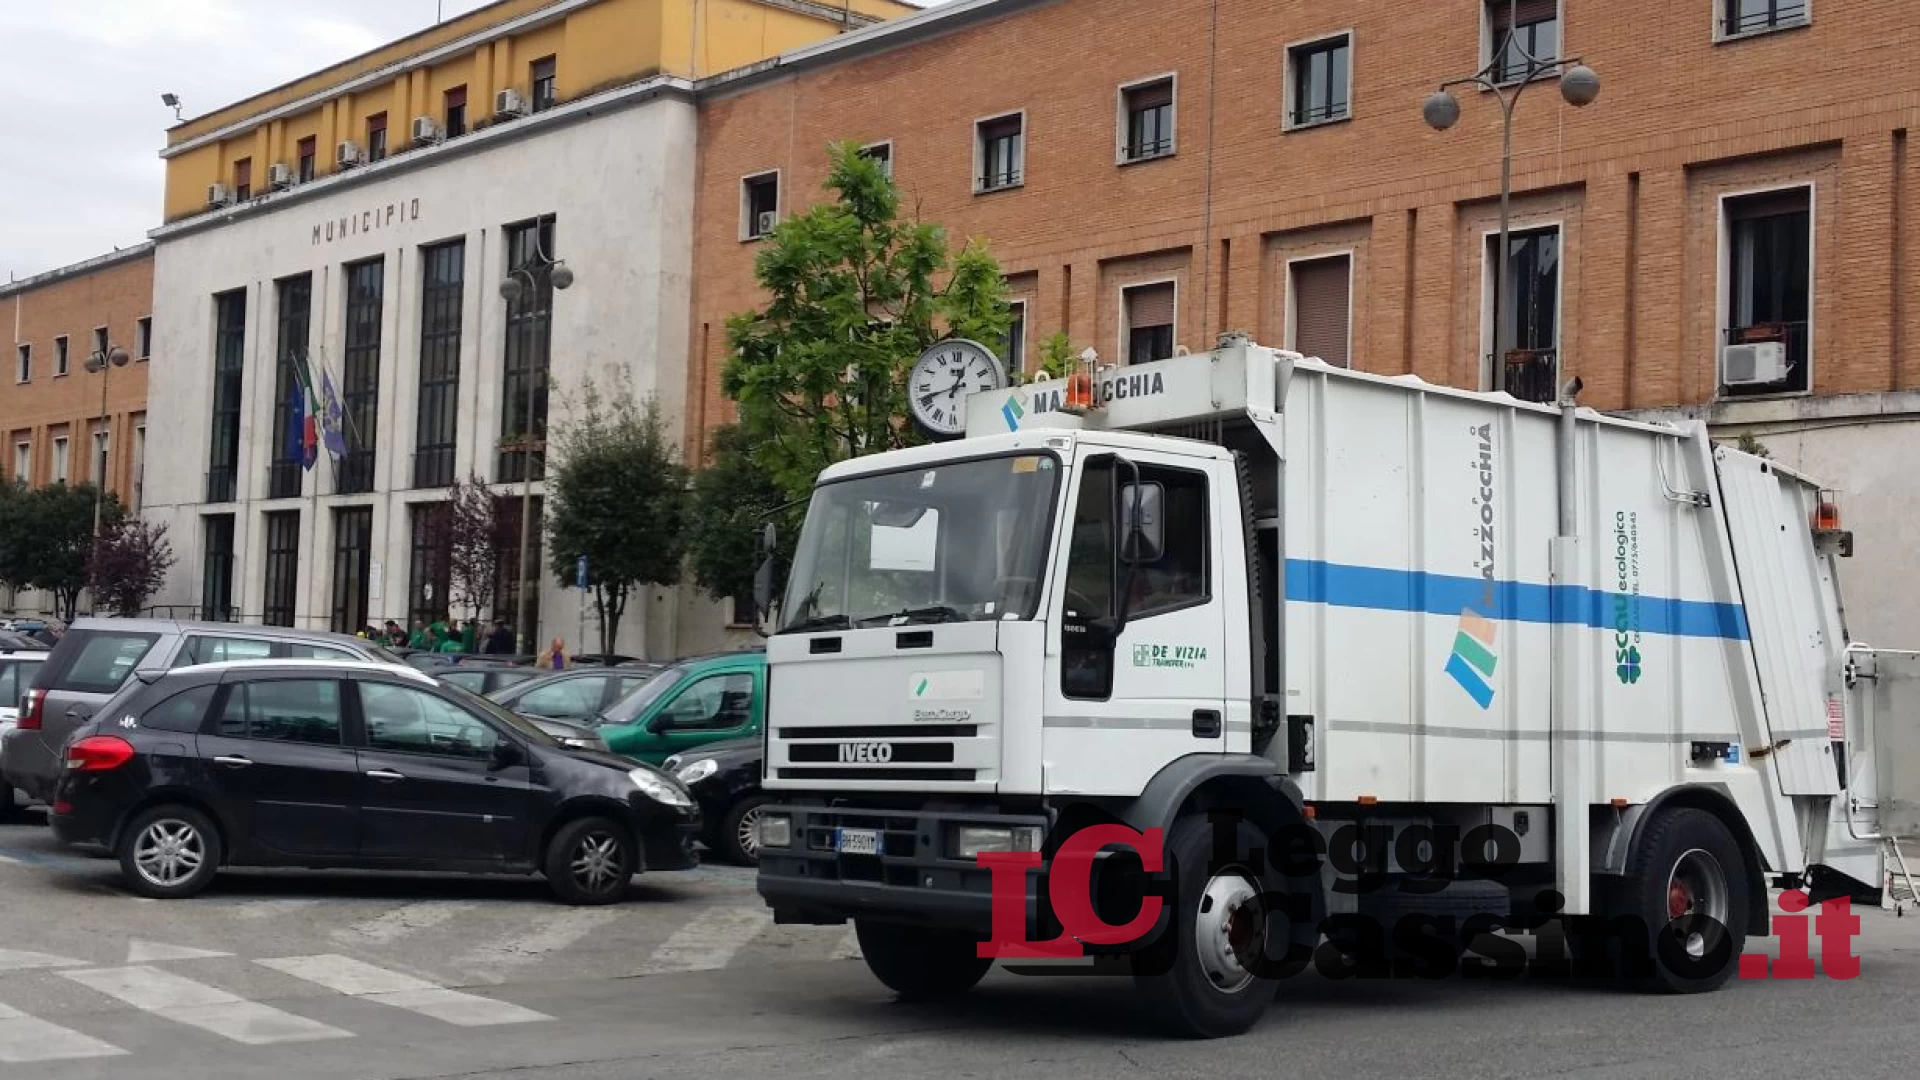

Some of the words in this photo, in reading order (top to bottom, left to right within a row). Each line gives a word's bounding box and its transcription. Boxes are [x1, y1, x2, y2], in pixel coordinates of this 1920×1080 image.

[312, 198, 419, 246] MUNICIPIO
[1034, 372, 1164, 414] MACCHIA
[1613, 511, 1628, 591] ecologica
[1152, 645, 1168, 658] DE
[1175, 646, 1207, 660] VIZIA
[838, 743, 892, 763] IVECO
